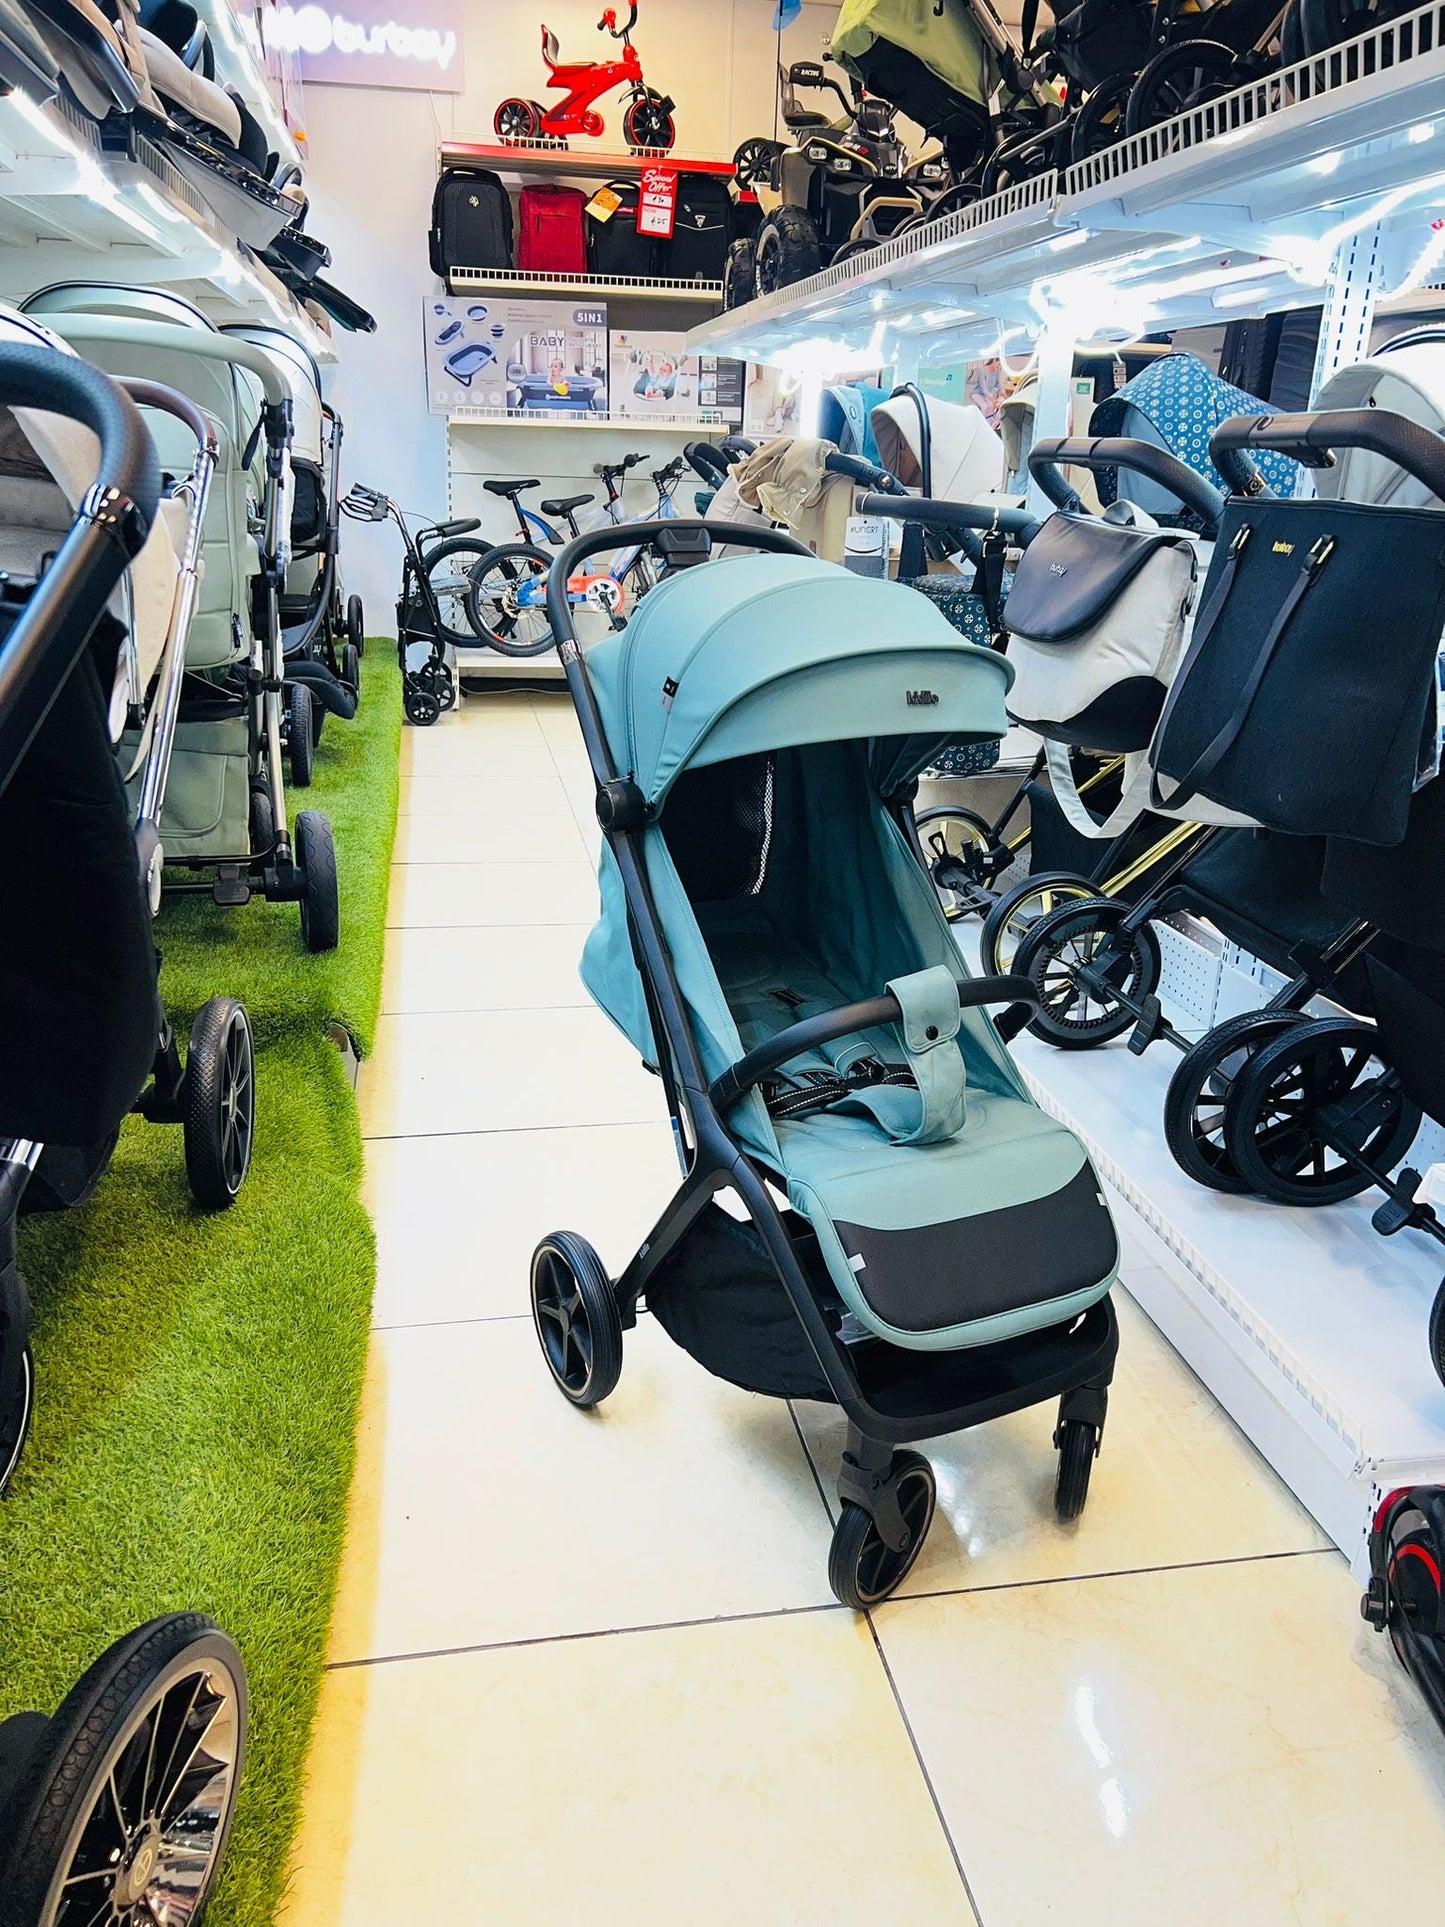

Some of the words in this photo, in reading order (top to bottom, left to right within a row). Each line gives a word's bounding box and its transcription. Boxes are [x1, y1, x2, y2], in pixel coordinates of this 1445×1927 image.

[800, 68, 820, 77] RACING
[643, 169, 677, 183] Special
[648, 181, 673, 193] Offer
[577, 312, 603, 323] 5IN1
[530, 336, 565, 347] BABY
